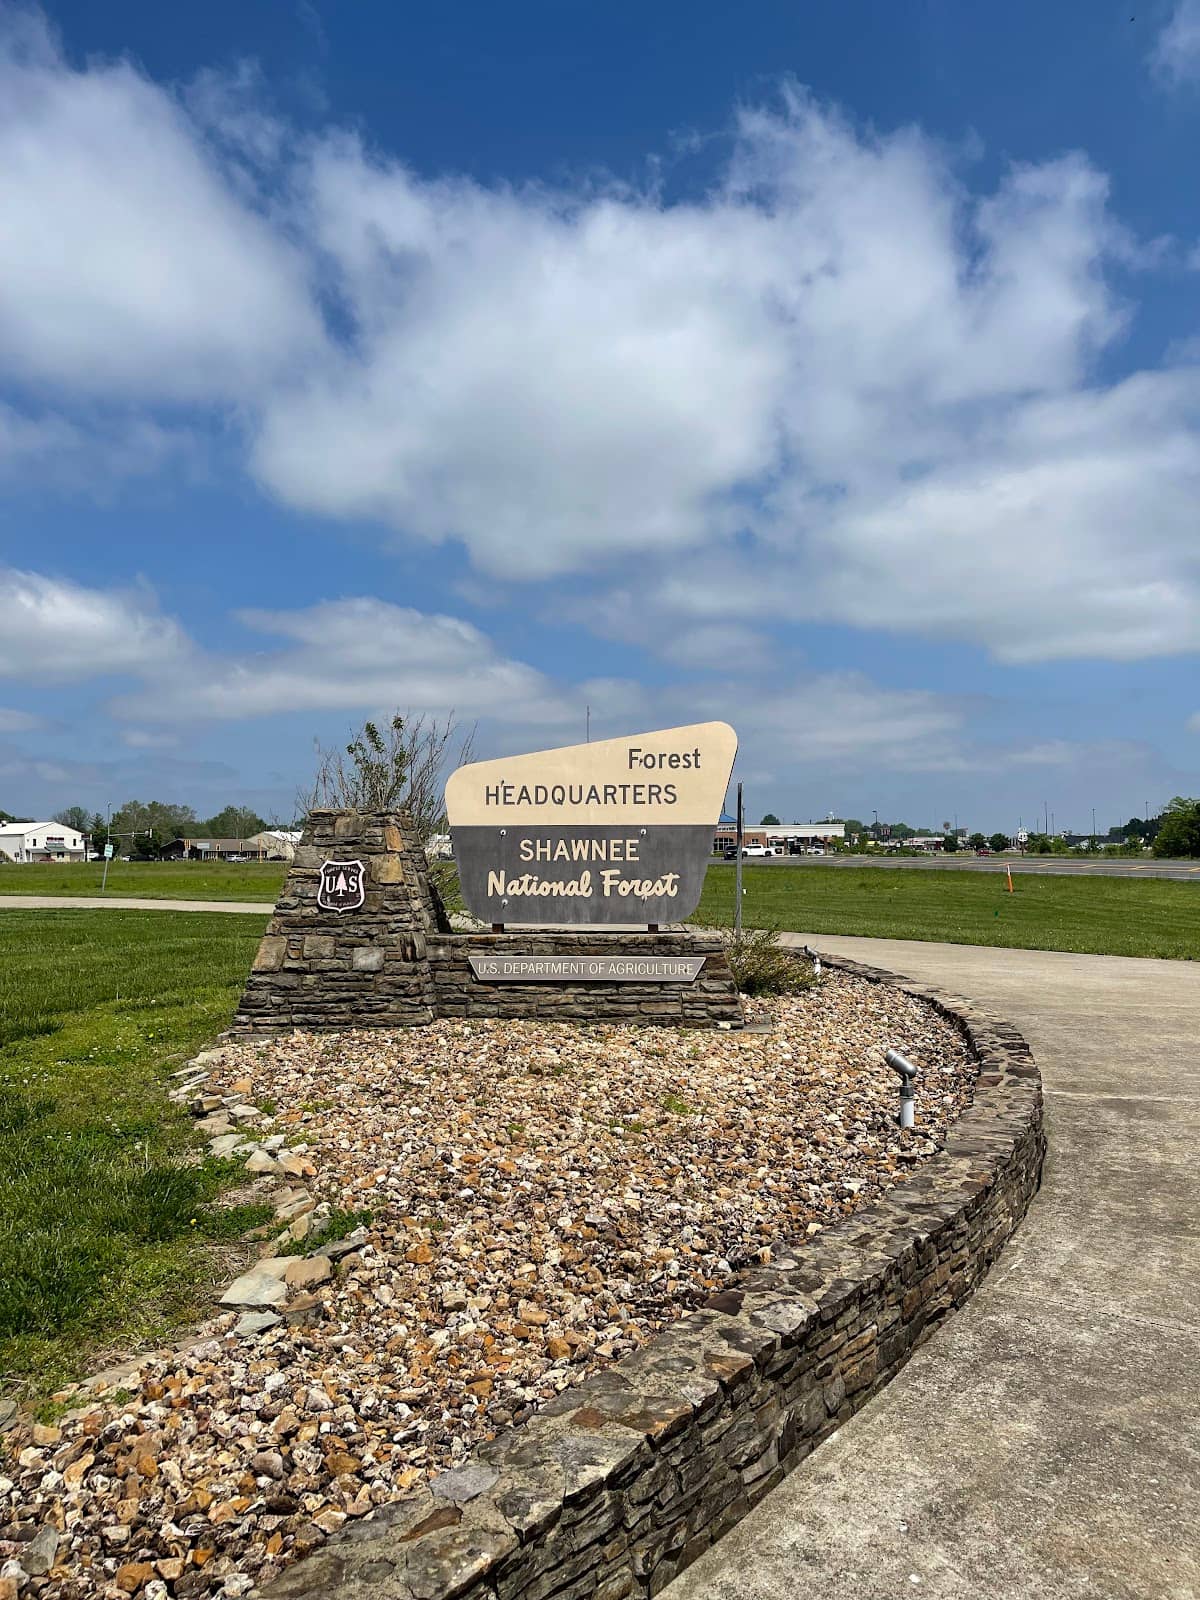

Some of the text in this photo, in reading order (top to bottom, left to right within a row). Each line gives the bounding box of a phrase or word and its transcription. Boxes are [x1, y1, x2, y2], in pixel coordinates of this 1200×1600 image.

[628, 748, 700, 769] Forest
[486, 784, 677, 805] HEADQUARTERS
[520, 840, 639, 861] SHAWNEE
[325, 876, 358, 893] U S
[488, 870, 679, 897] National Forest
[478, 963, 694, 975] U.S. DEPARTMENT OF AGRICULTURE
